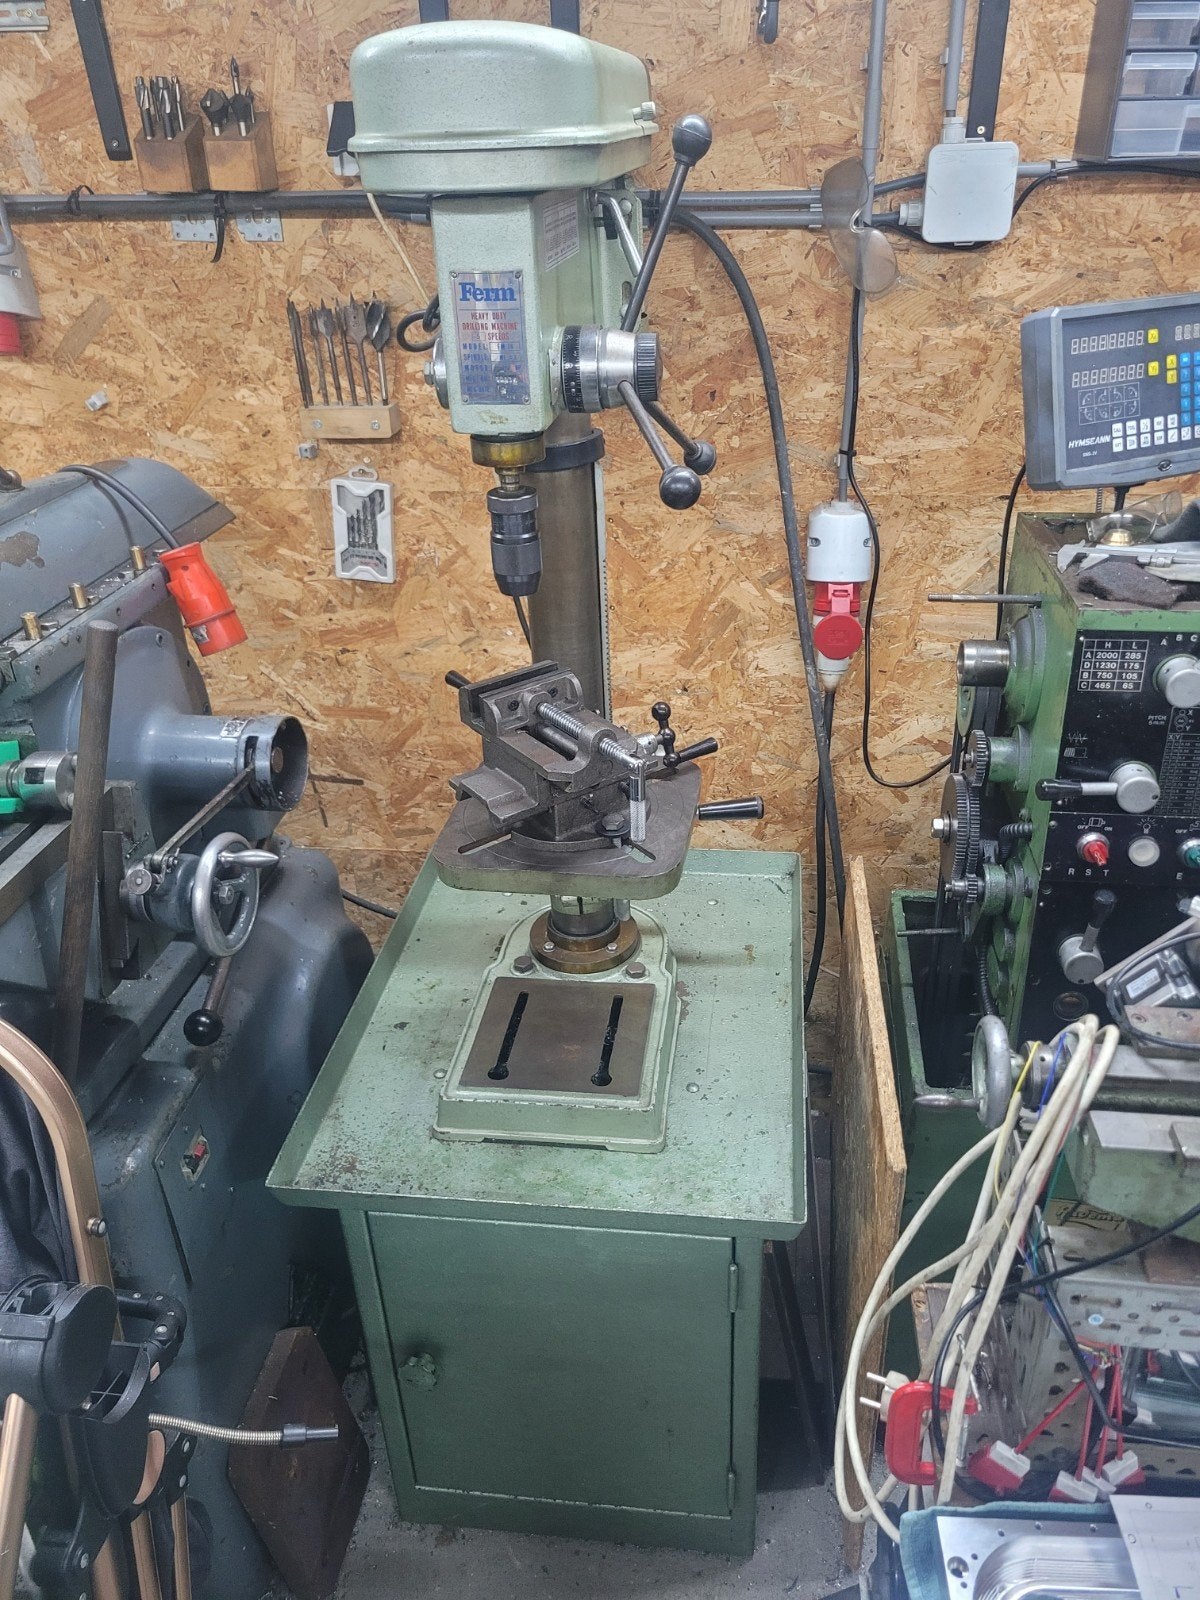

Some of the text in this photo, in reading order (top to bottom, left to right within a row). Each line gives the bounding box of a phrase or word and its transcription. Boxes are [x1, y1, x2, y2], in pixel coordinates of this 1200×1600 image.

[458, 282, 517, 302] Ferm
[470, 312, 488, 320] HEAVY
[462, 322, 517, 330] DRILLING MACHINE
